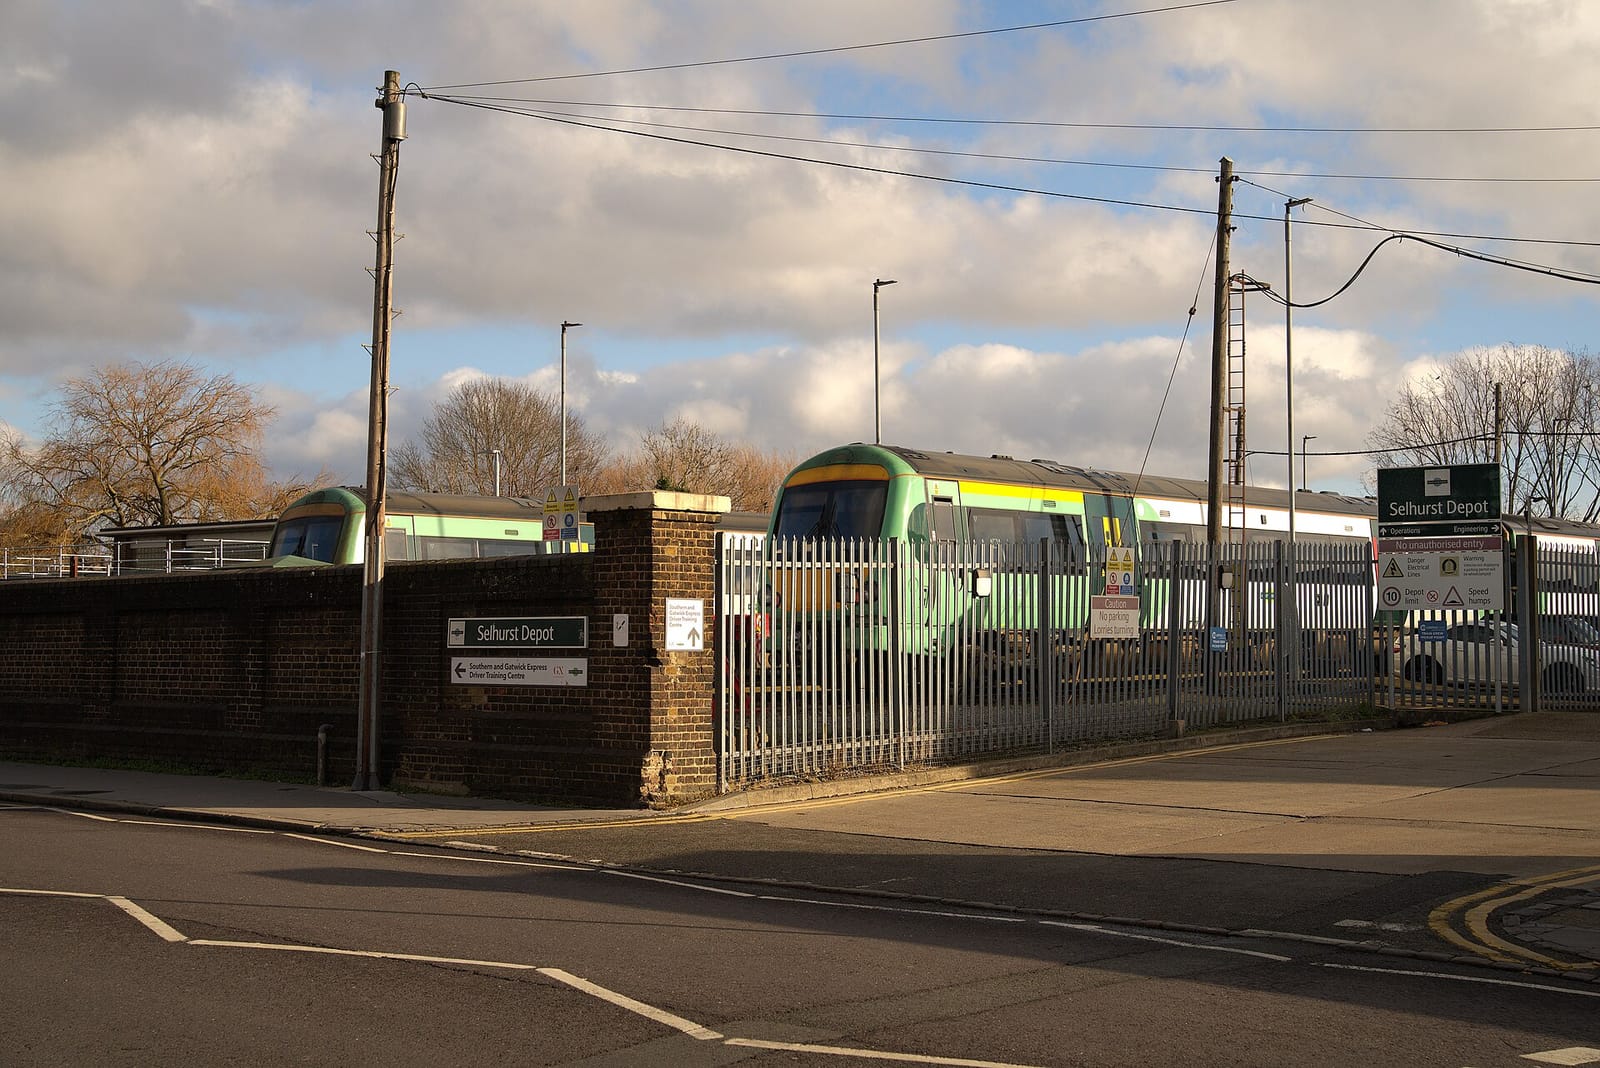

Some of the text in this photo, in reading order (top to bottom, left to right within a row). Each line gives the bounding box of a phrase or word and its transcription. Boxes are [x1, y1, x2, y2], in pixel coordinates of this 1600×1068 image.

[1389, 500, 1489, 517] Selhurst Depot
[1390, 527, 1421, 535] Operations
[1453, 525, 1489, 534] Engineering
[1395, 539, 1485, 549] No unauthorised entry
[1386, 592, 1397, 601] 10
[1405, 588, 1424, 597] Depot
[1468, 587, 1489, 597] Speed
[1104, 599, 1127, 609] Caution
[1405, 597, 1419, 605] limit
[1468, 597, 1491, 606] humps
[1099, 611, 1130, 623] No parking
[477, 624, 554, 645] Selhurst Depot
[1093, 623, 1134, 636] Lorries turning
[469, 662, 548, 672] Southern and Gatwick Express
[486, 672, 507, 680] Training
